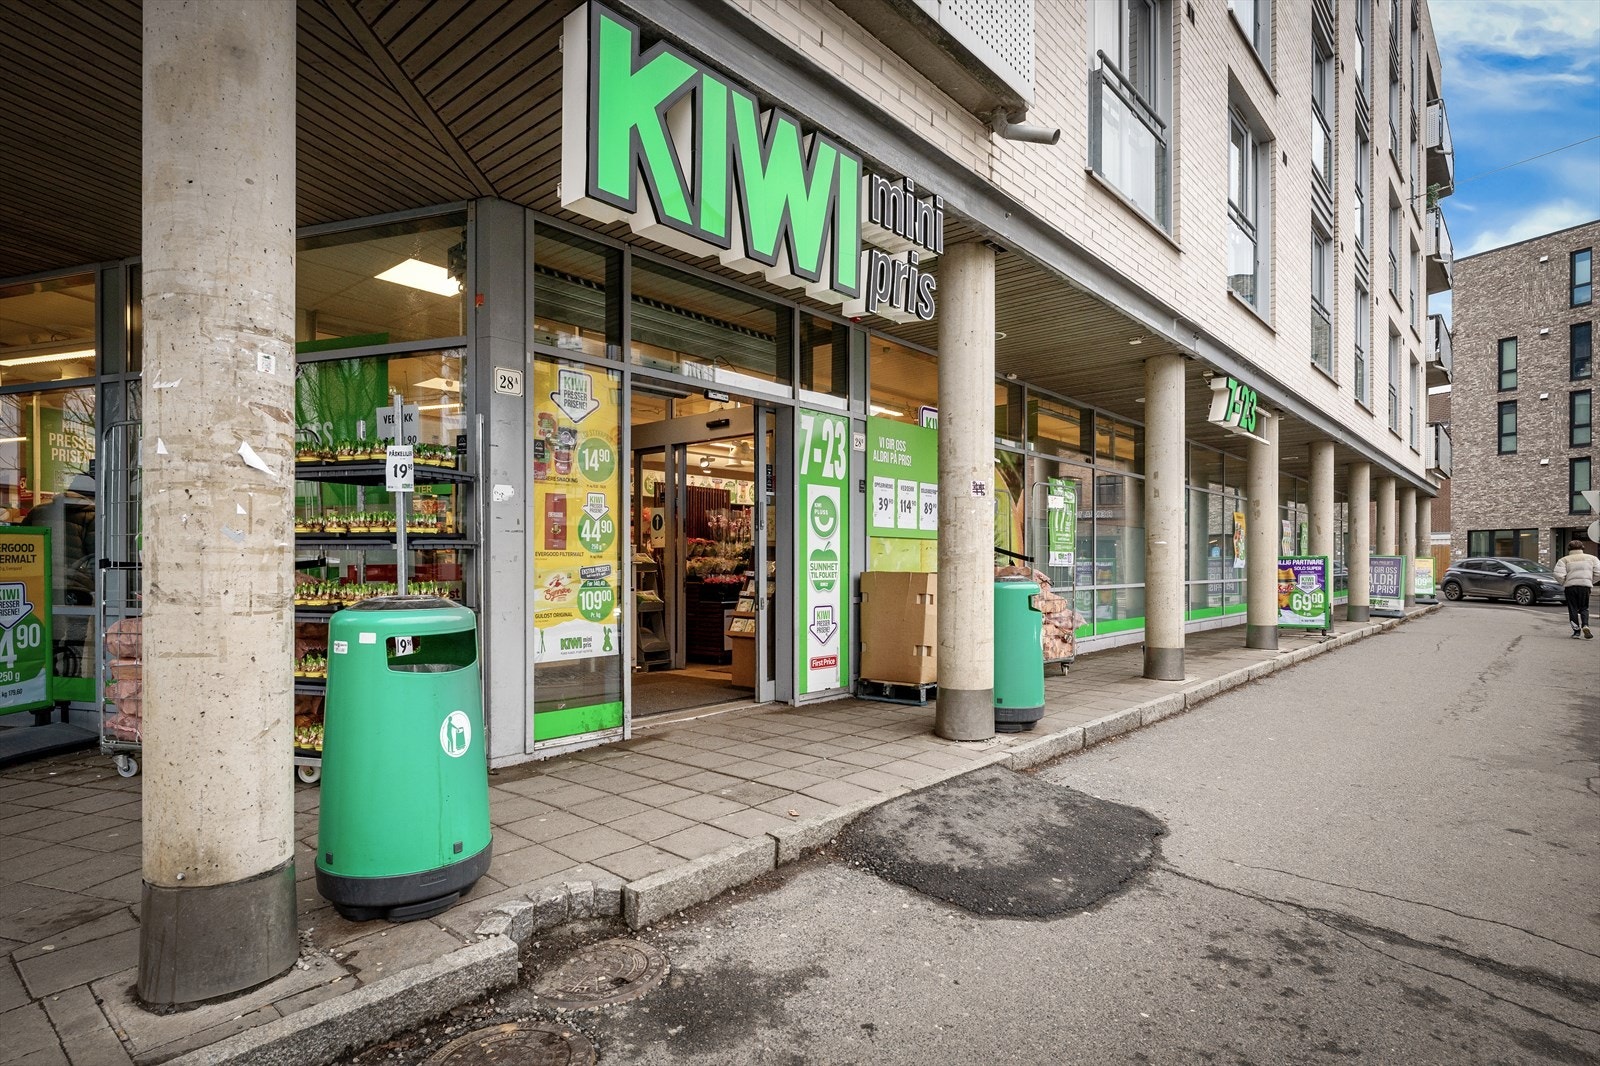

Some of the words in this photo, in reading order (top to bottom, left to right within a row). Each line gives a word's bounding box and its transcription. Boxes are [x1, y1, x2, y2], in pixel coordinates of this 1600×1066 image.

[592, 6, 862, 295] KIWI
[871, 173, 944, 256] mini
[870, 249, 936, 321] pris
[564, 376, 587, 392] KIWI
[564, 390, 587, 401] PRESSER
[564, 399, 587, 410] PRISENE!
[1226, 377, 1257, 433] 7-23
[801, 415, 846, 480] 7-23
[879, 436, 884, 448] VI
[886, 438, 895, 450] GIR
[896, 440, 906, 452] OSS
[873, 450, 889, 463] ALDRI
[890, 450, 897, 464] PÅ
[898, 454, 912, 467] PRIS!
[0, 544, 34, 552] RGOOD
[810, 563, 838, 571] SUNNHET
[1374, 566, 1385, 574] GIR
[1369, 573, 1397, 586] ALDRI
[817, 610, 830, 620] KIWI
[560, 637, 582, 650] KIWI
[823, 658, 836, 666] Price
